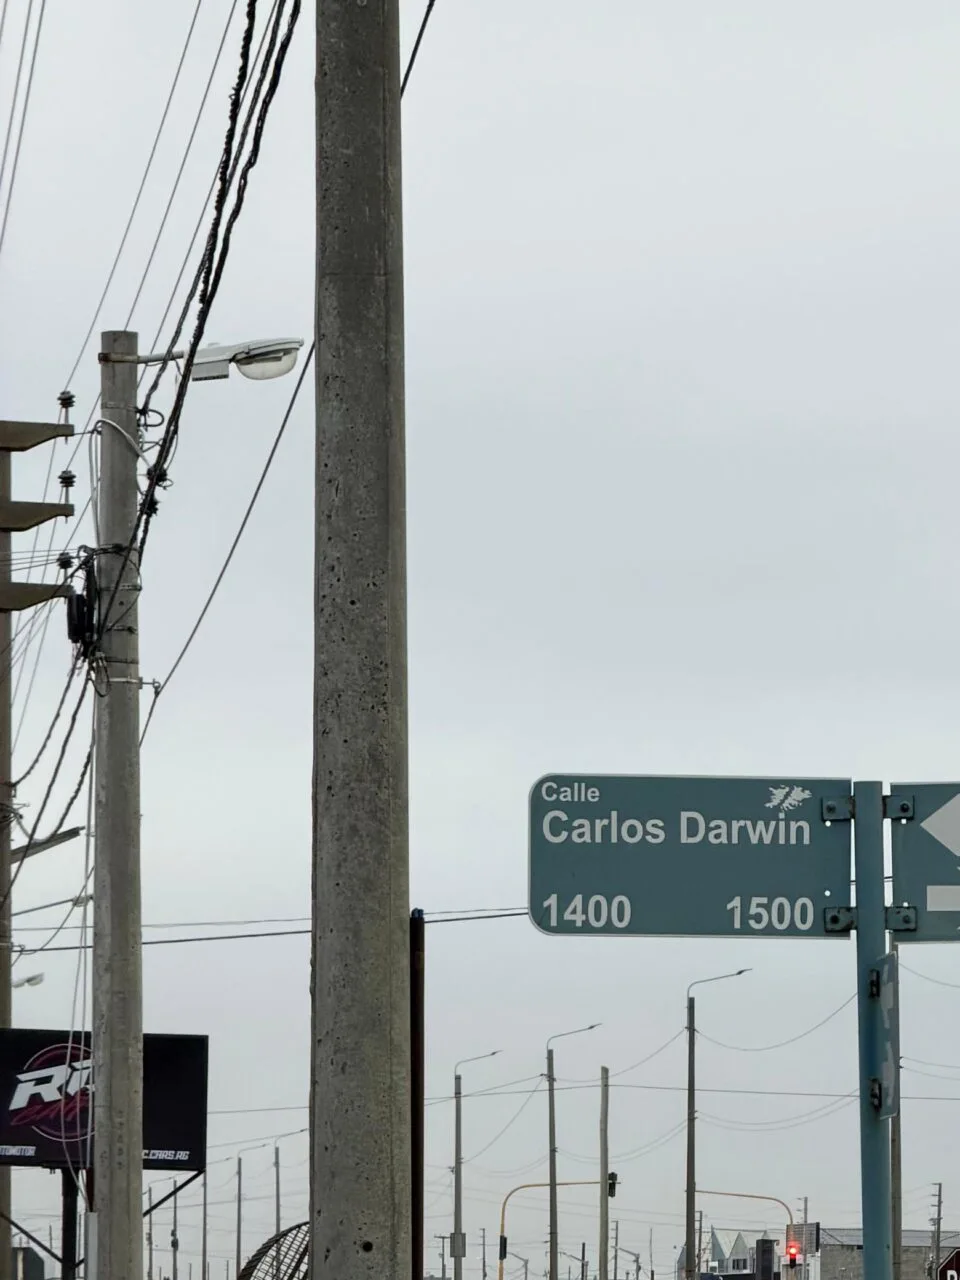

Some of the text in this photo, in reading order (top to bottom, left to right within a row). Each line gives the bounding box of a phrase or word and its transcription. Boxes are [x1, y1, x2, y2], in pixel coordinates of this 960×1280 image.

[541, 782, 600, 802] Calle
[541, 810, 811, 845] Carlos Darwin
[542, 894, 814, 930] 1400 1500
